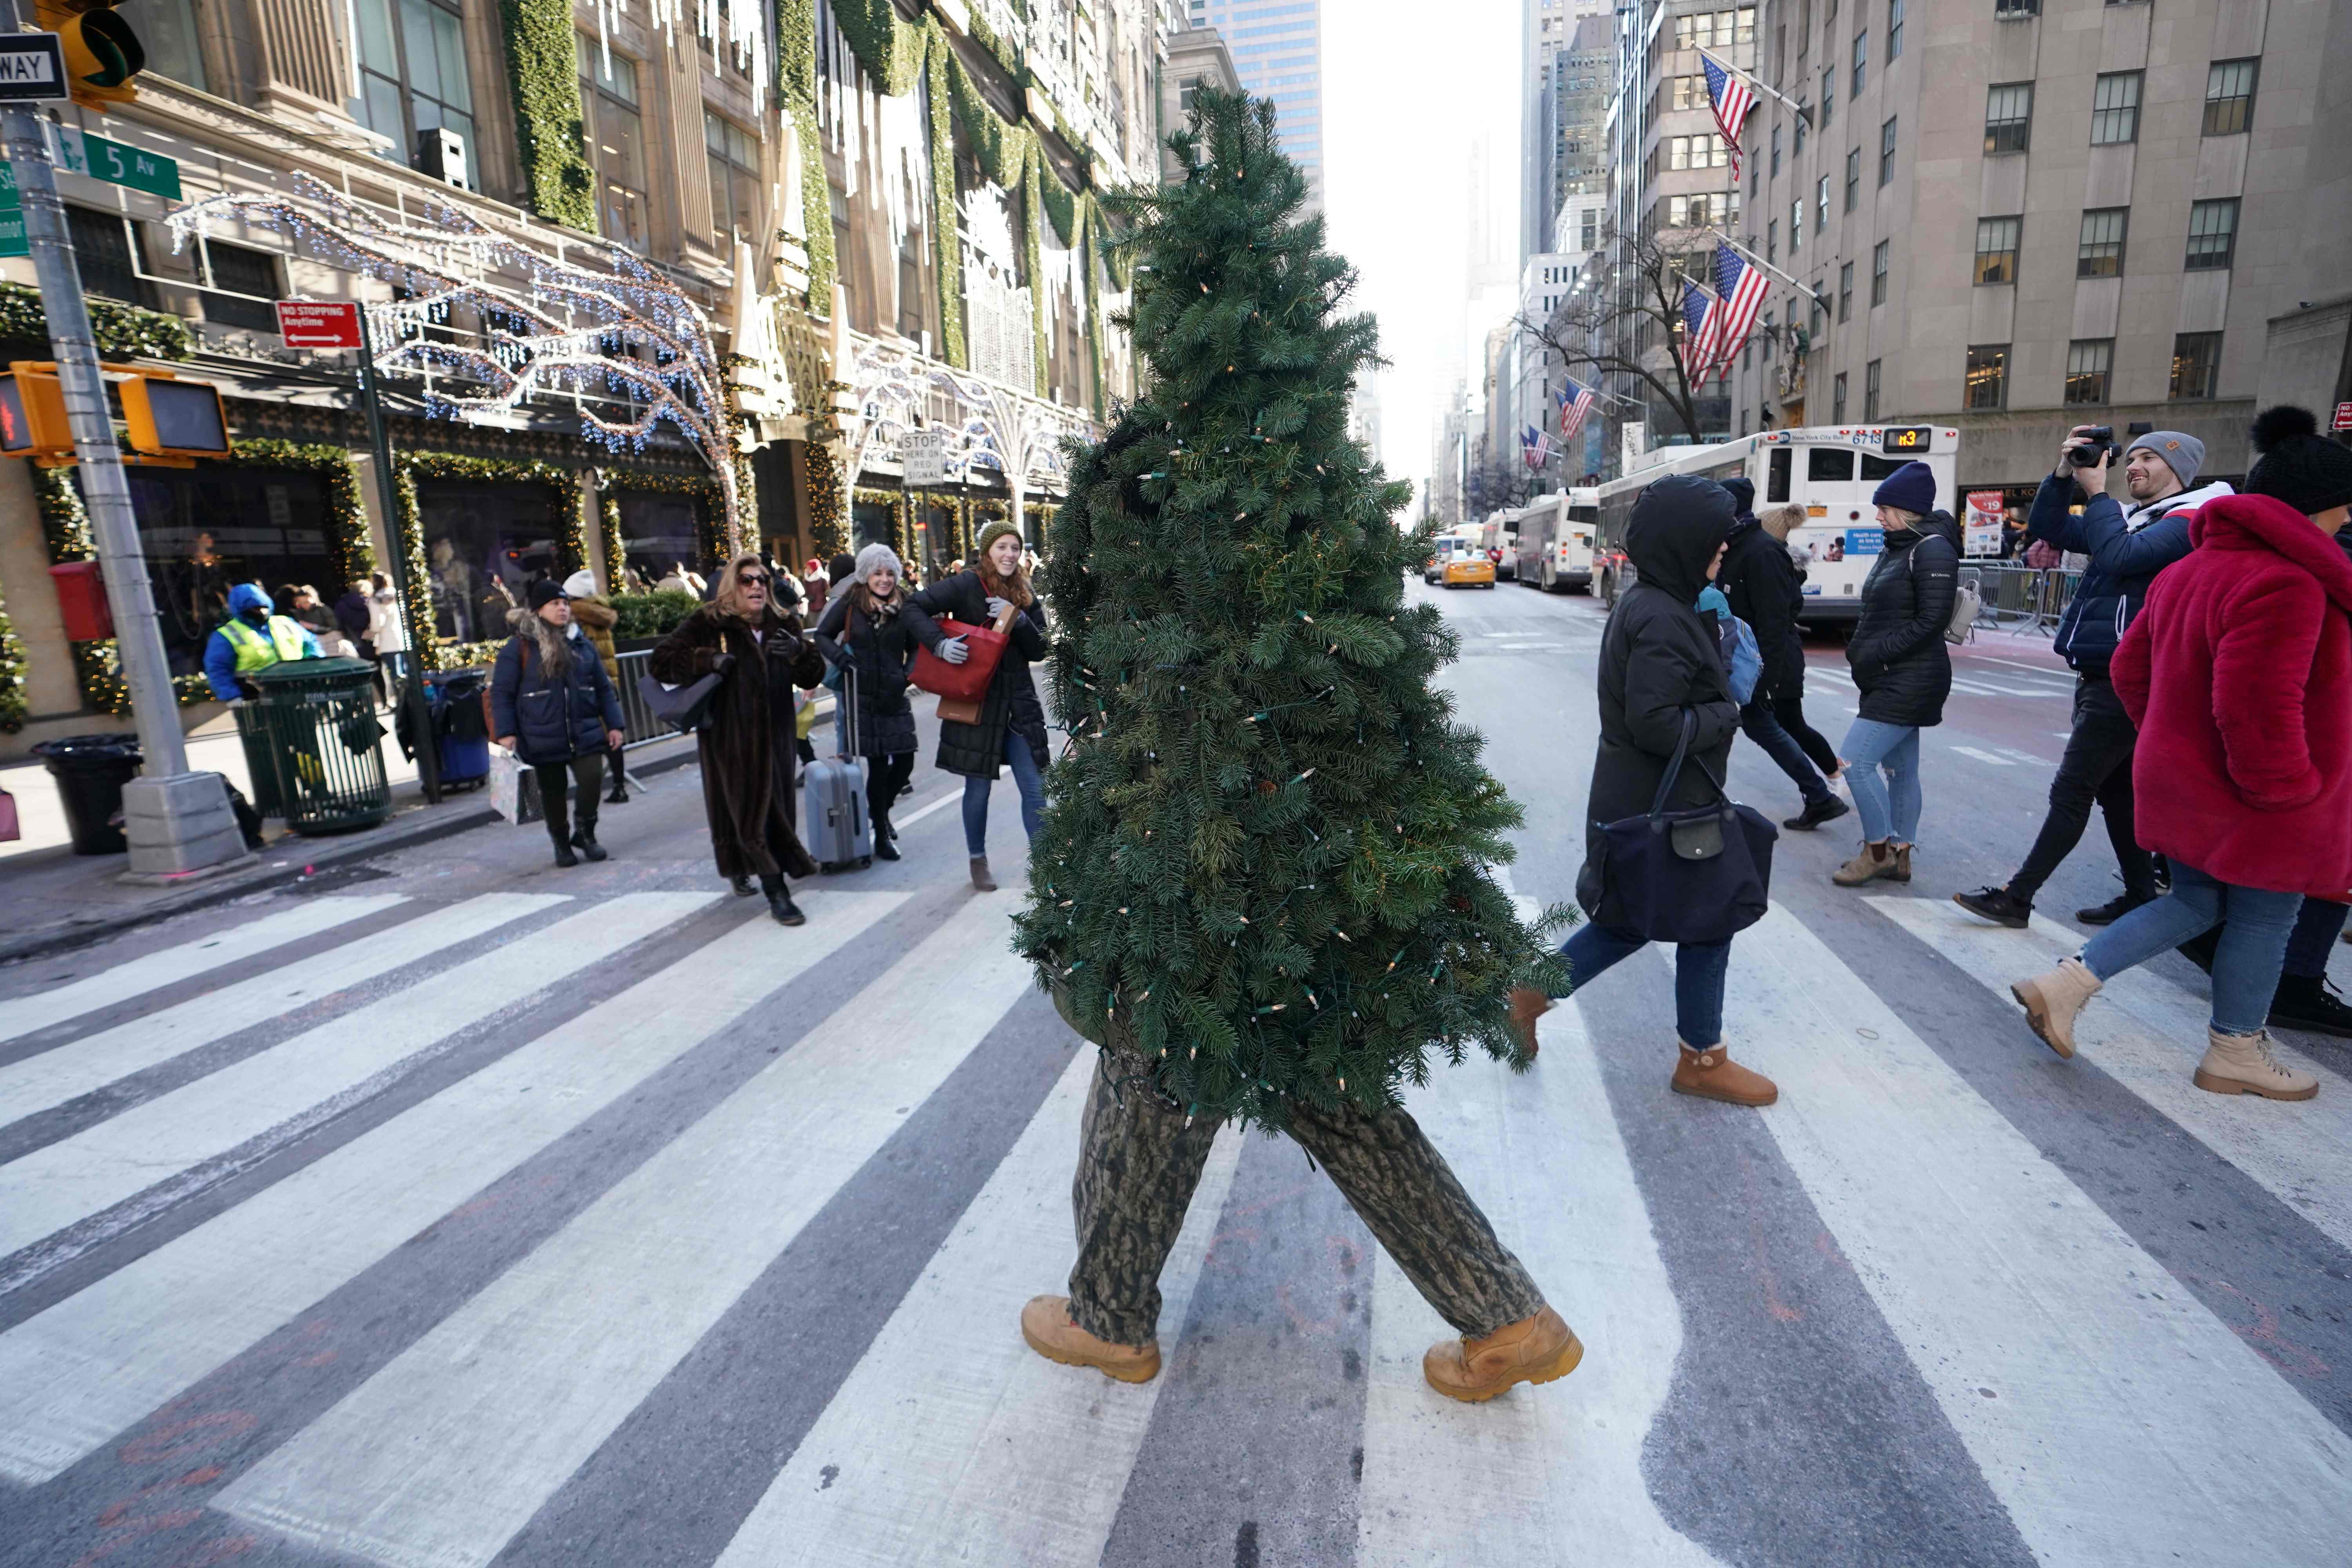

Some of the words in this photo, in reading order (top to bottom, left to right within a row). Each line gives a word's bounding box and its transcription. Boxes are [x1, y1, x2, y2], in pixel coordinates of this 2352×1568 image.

[0, 55, 40, 79] WAY
[106, 146, 125, 178] 5
[137, 155, 155, 176] Av
[281, 306, 296, 315] NO
[297, 306, 345, 316] STOPPING
[284, 317, 324, 328] Anytime
[904, 436, 938, 448] STOP
[1852, 433, 1882, 445] 6713
[1899, 431, 1916, 446] M3
[905, 449, 925, 458] HERE
[928, 448, 939, 458] ON
[913, 460, 931, 468] RED
[907, 470, 940, 479] SIGNAL
